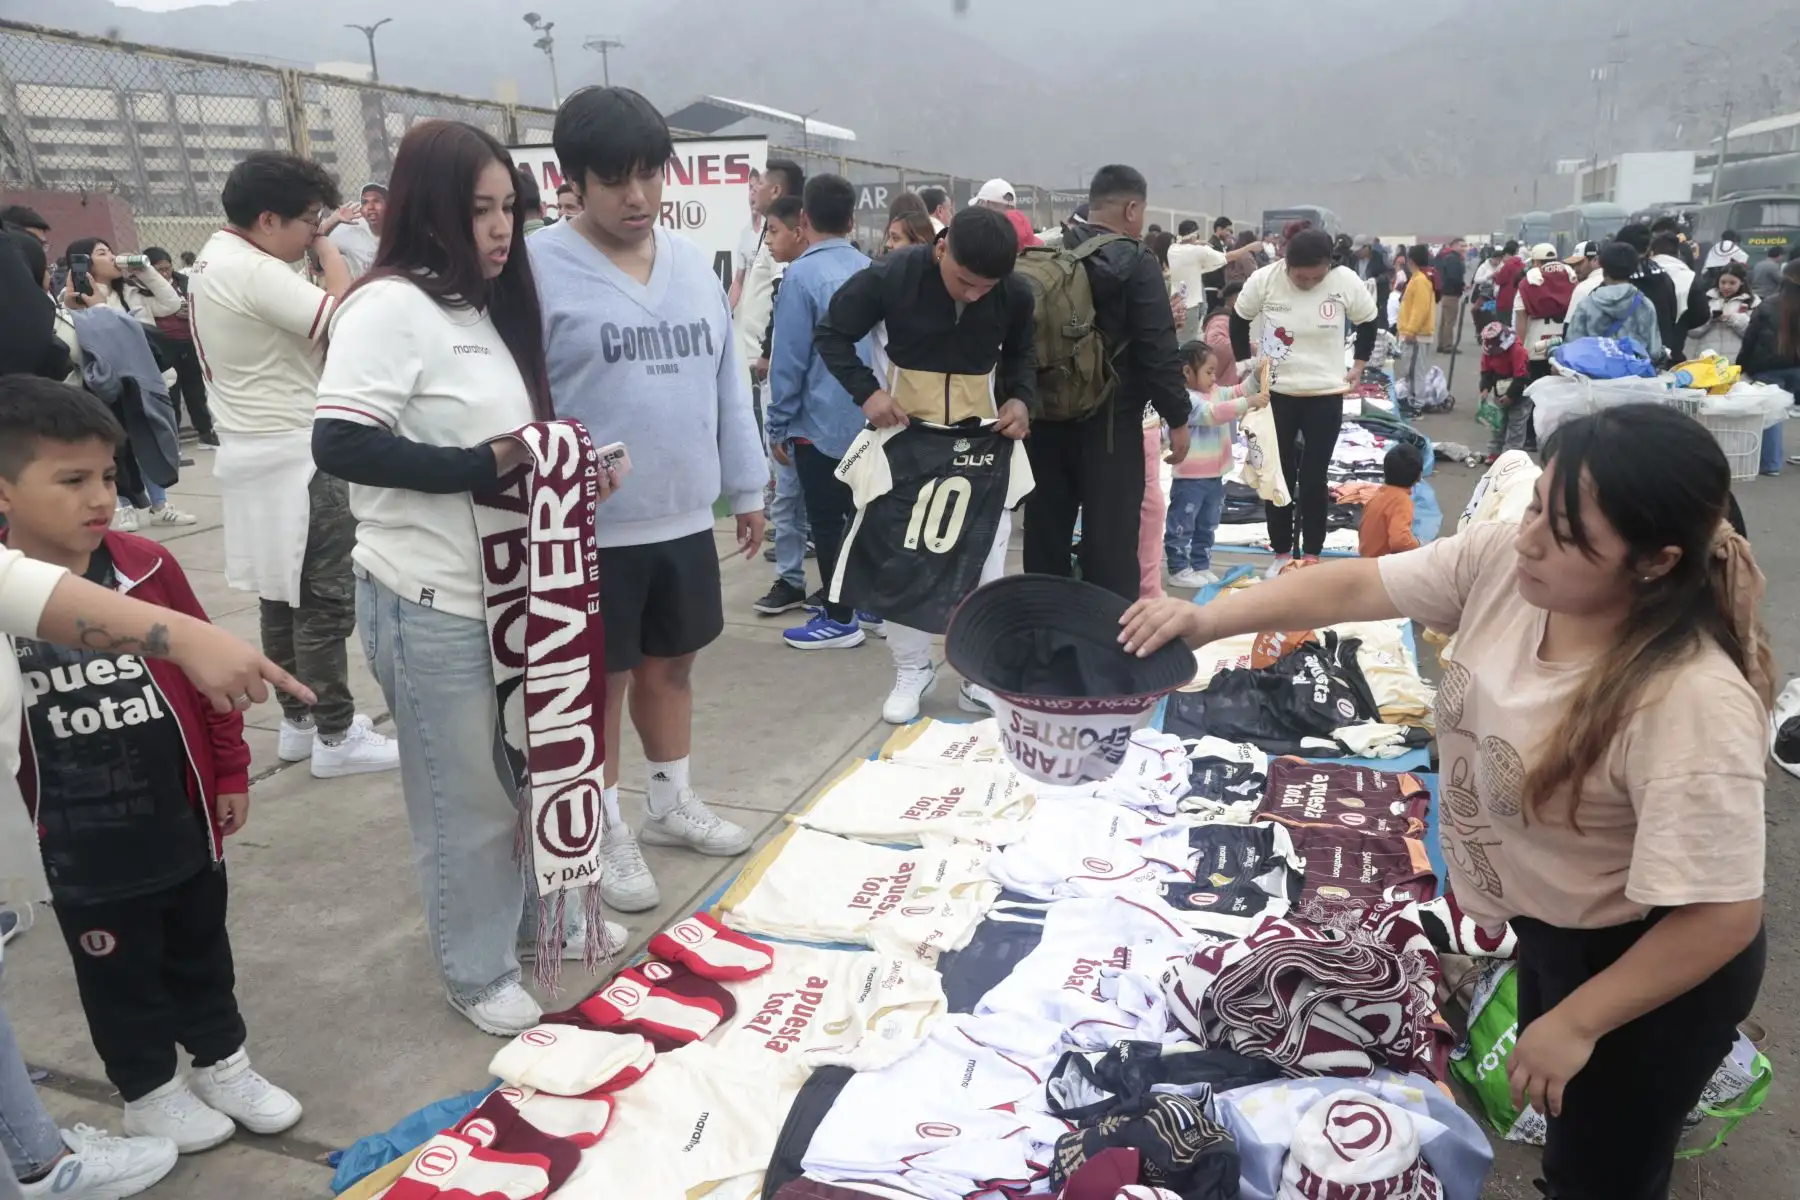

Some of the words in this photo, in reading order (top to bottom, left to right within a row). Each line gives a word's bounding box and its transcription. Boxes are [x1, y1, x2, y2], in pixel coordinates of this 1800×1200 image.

[600, 317, 714, 364] Comfort
[645, 364, 656, 376] IN
[656, 363, 680, 376] PARIS
[903, 476, 972, 554] 10
[22, 653, 145, 708] pues
[47, 683, 165, 739] total
[1280, 783, 1308, 808] total
[1303, 773, 1330, 819] apuesta
[1332, 846, 1343, 878] marathon
[848, 877, 889, 910] total
[84, 932, 113, 955] U
[676, 925, 702, 943] U
[646, 962, 671, 979] U
[609, 988, 638, 1005] U
[741, 990, 794, 1036] total
[764, 974, 829, 1054] apuesta
[523, 1030, 556, 1046] U
[418, 1149, 455, 1175] U
